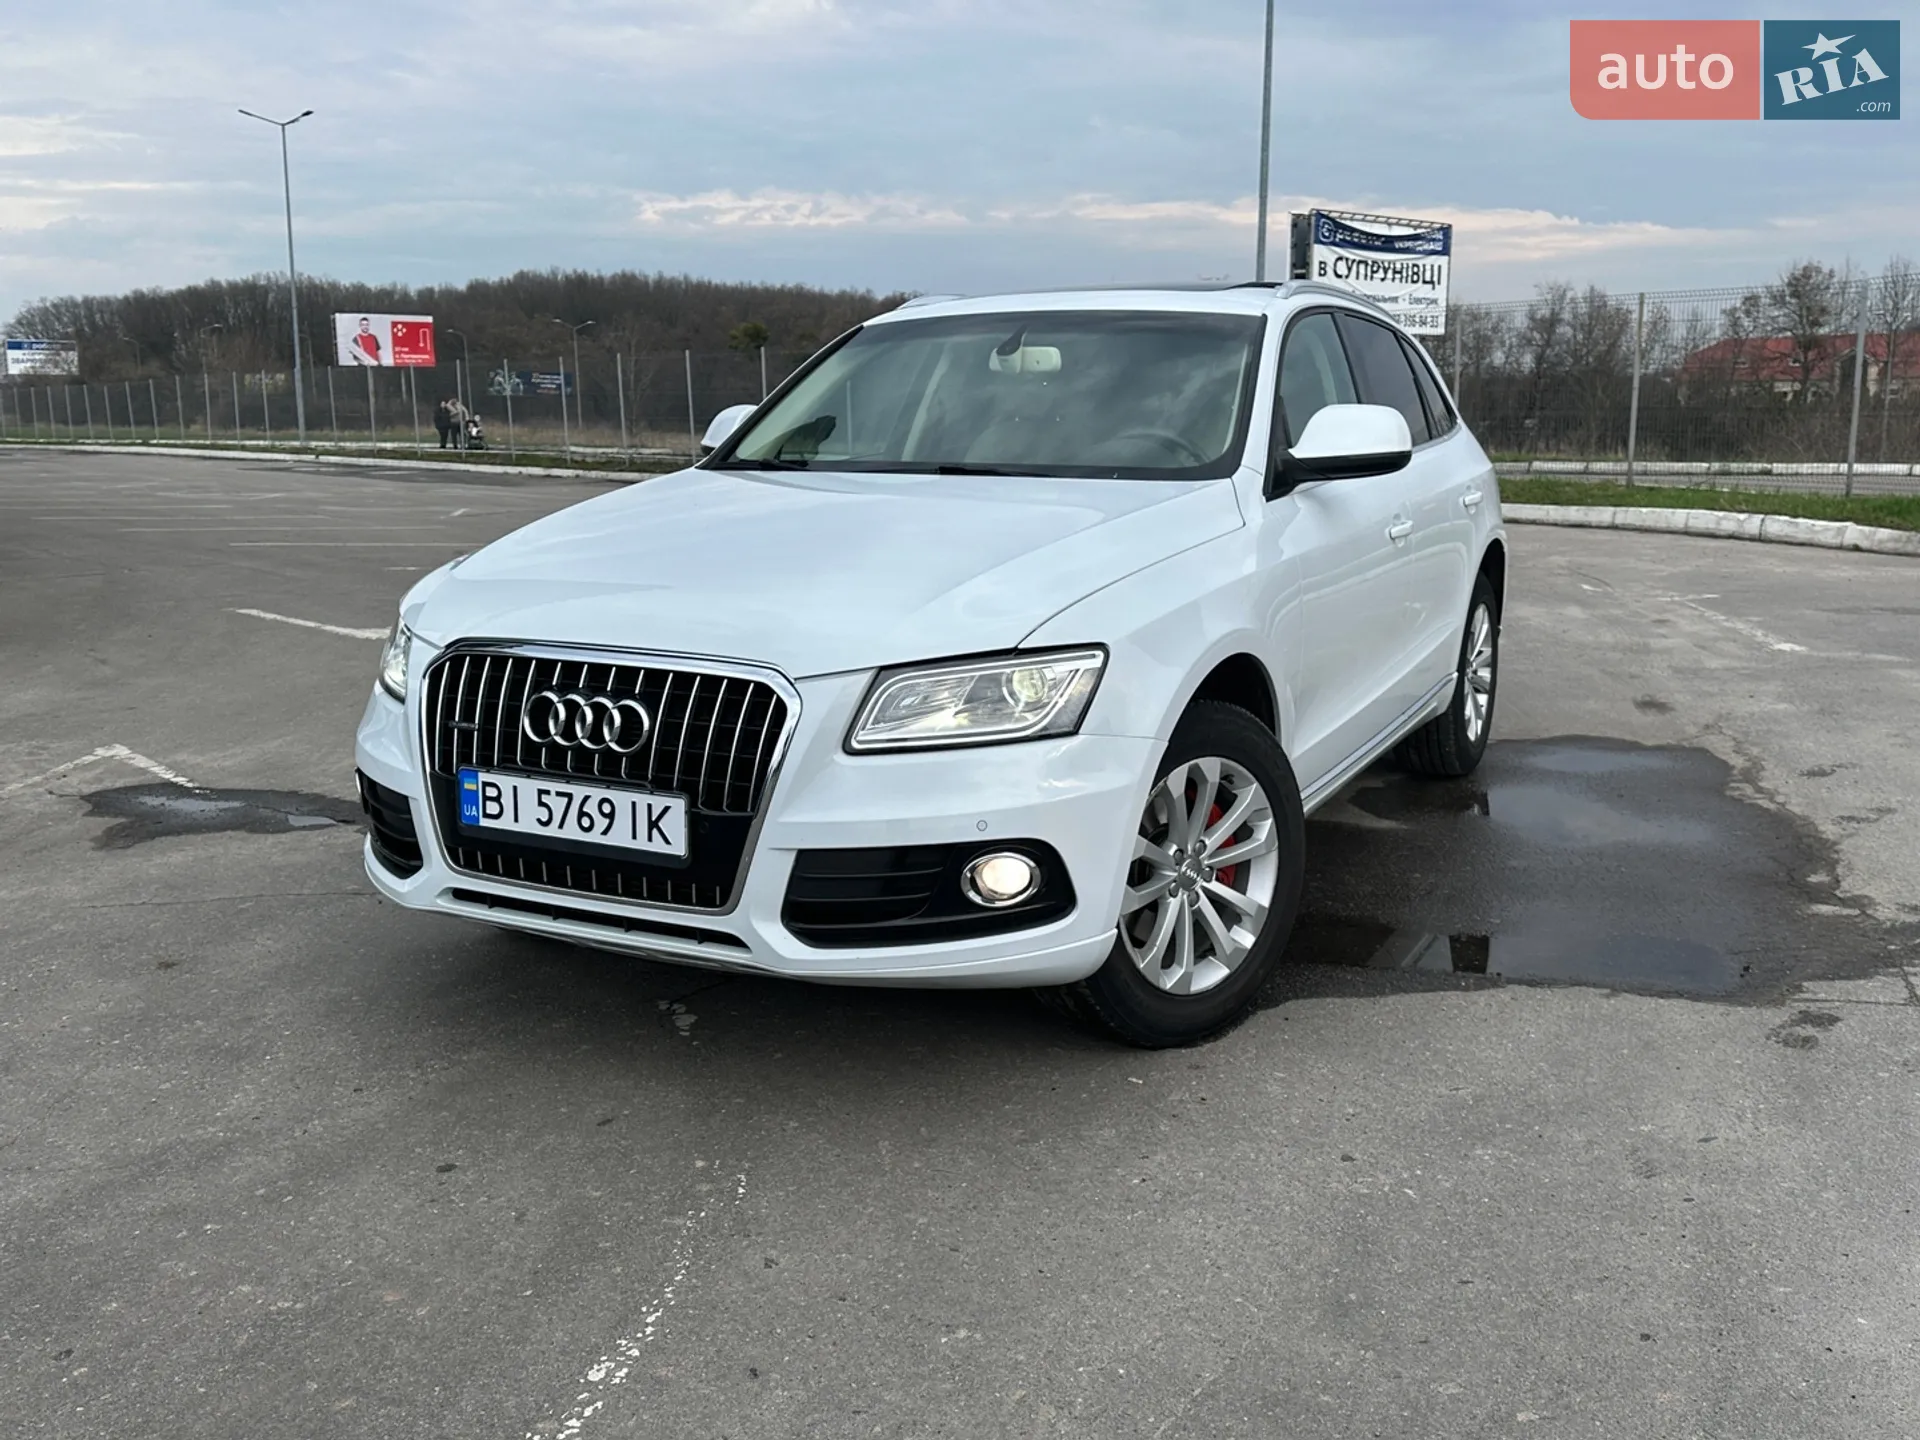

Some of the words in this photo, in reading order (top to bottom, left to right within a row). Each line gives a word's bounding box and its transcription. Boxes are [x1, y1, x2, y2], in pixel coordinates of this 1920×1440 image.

[1318, 261, 1327, 277] в
[1333, 256, 1442, 290] СУПРУНІВЦІ
[463, 804, 478, 816] UA
[481, 780, 519, 823] BI
[535, 788, 616, 836] 5769
[631, 801, 672, 846] IK
